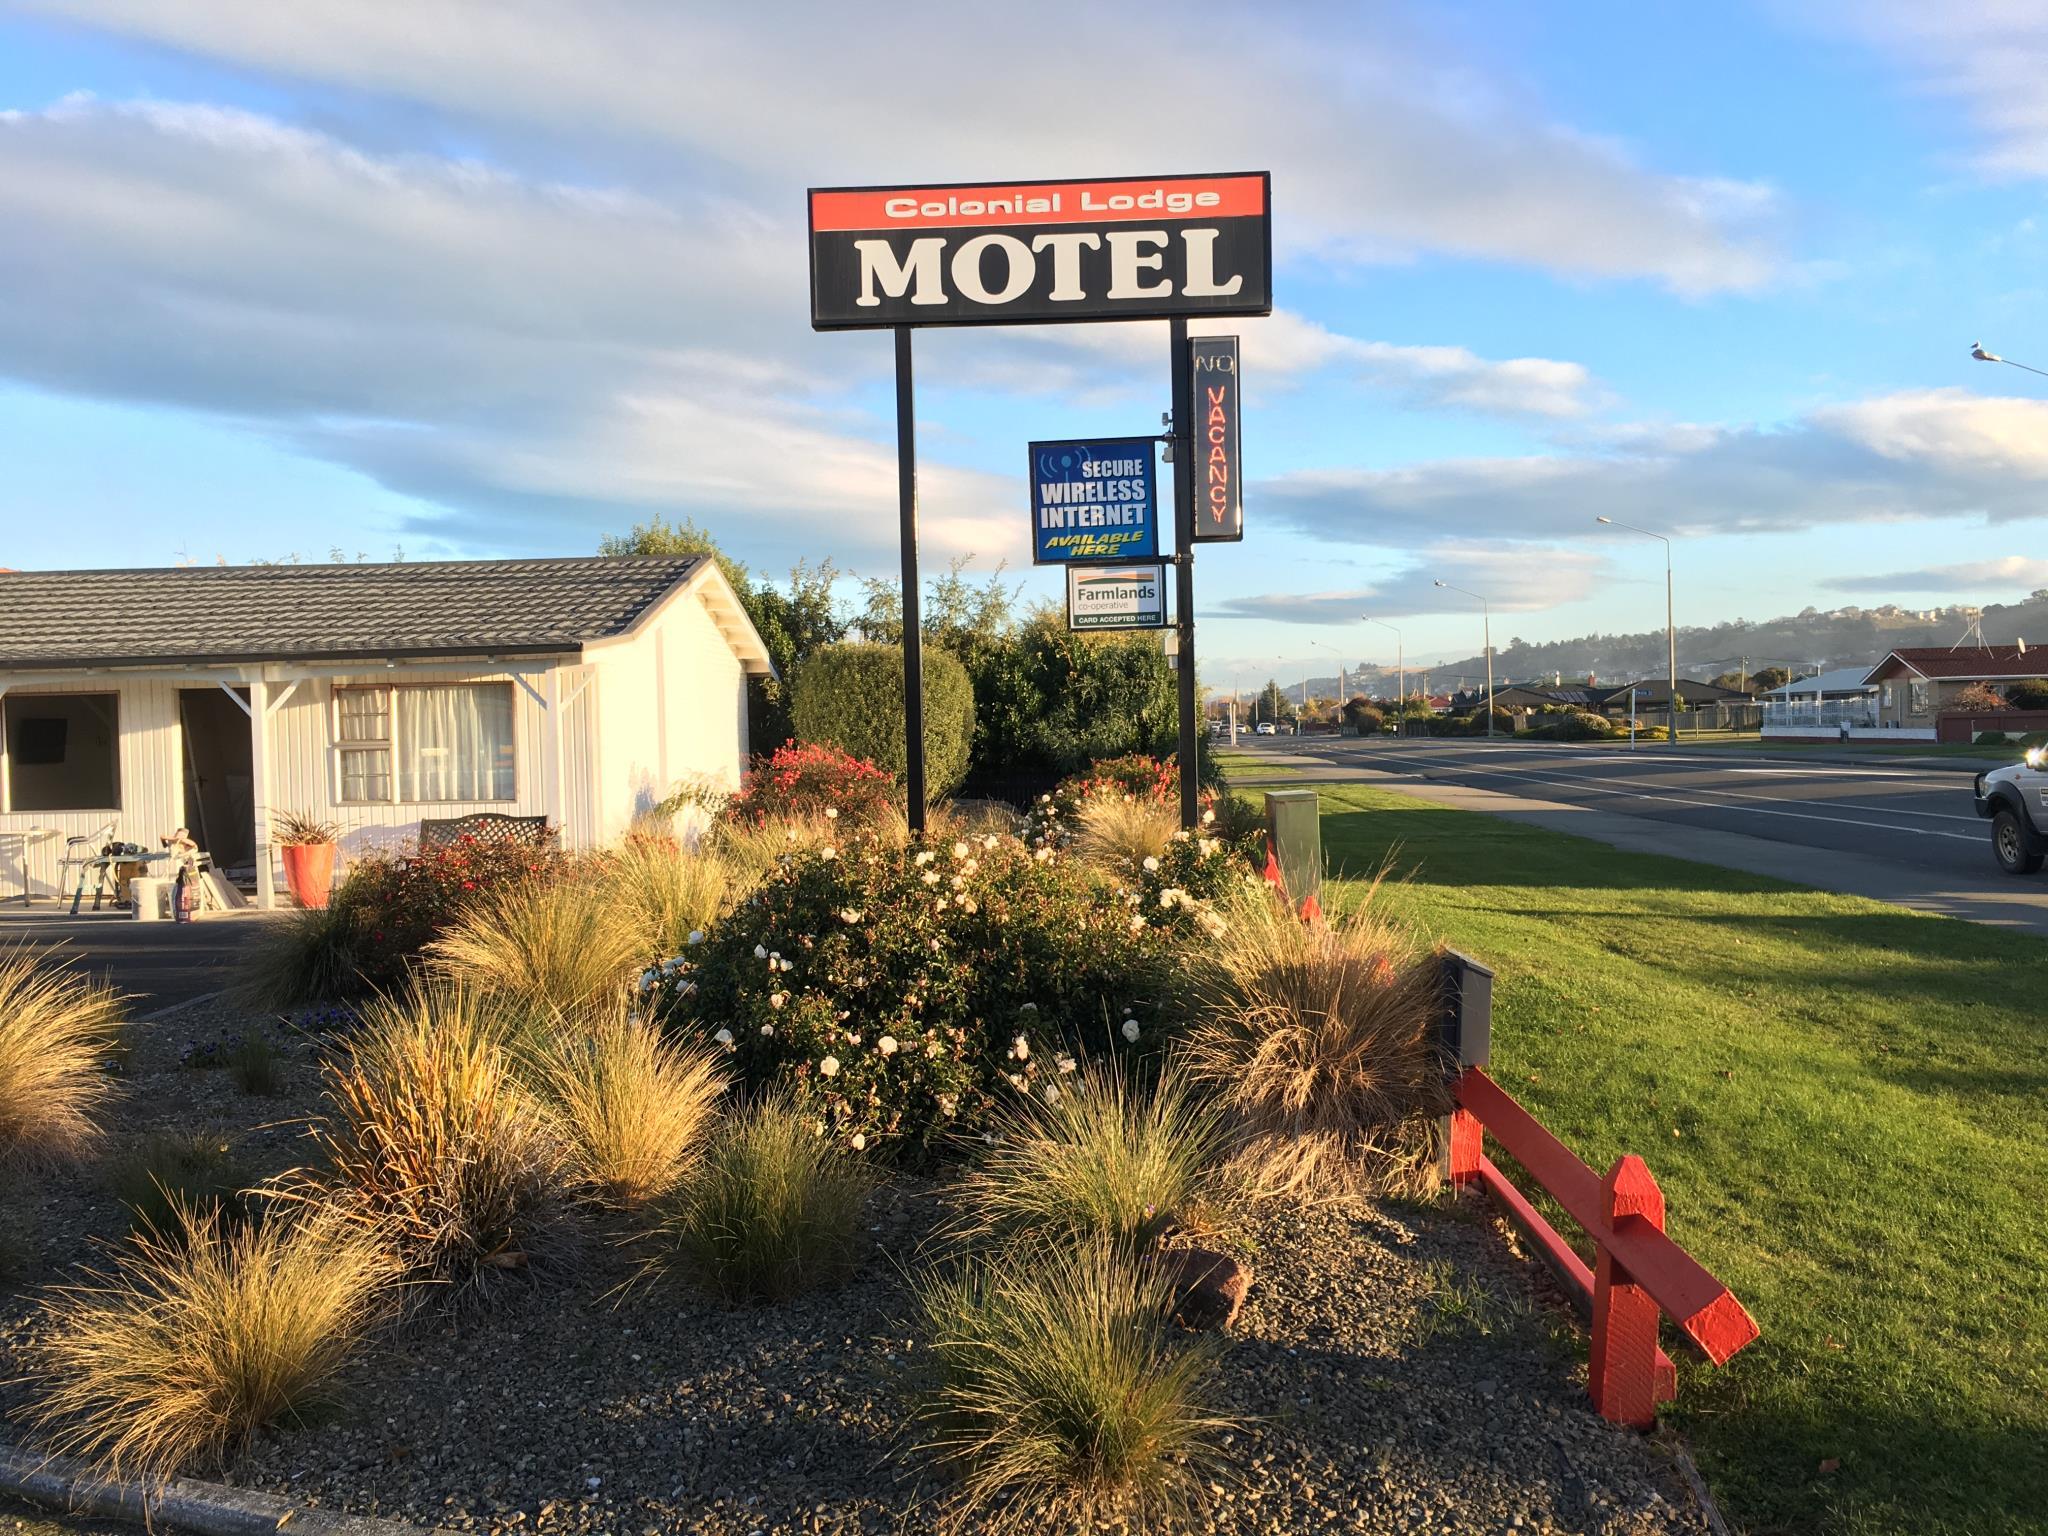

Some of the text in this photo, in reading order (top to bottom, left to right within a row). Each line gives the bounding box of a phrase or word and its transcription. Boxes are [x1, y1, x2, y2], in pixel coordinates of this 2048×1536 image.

[884, 189, 1221, 219] Colonial Lodge
[853, 228, 1244, 307] MOTEL
[1208, 385, 1228, 523] VACANCY
[1082, 459, 1143, 478] SECURE
[1040, 479, 1146, 505] WIRELESS
[1040, 503, 1147, 529] INTERNET
[1045, 531, 1144, 548] AVAILABLE
[1071, 545, 1120, 556] HERE
[1078, 585, 1155, 601] Farmlands
[1078, 600, 1129, 611] co-operative
[1099, 615, 1136, 623] ACCEPTED
[1137, 614, 1156, 622] HERE
